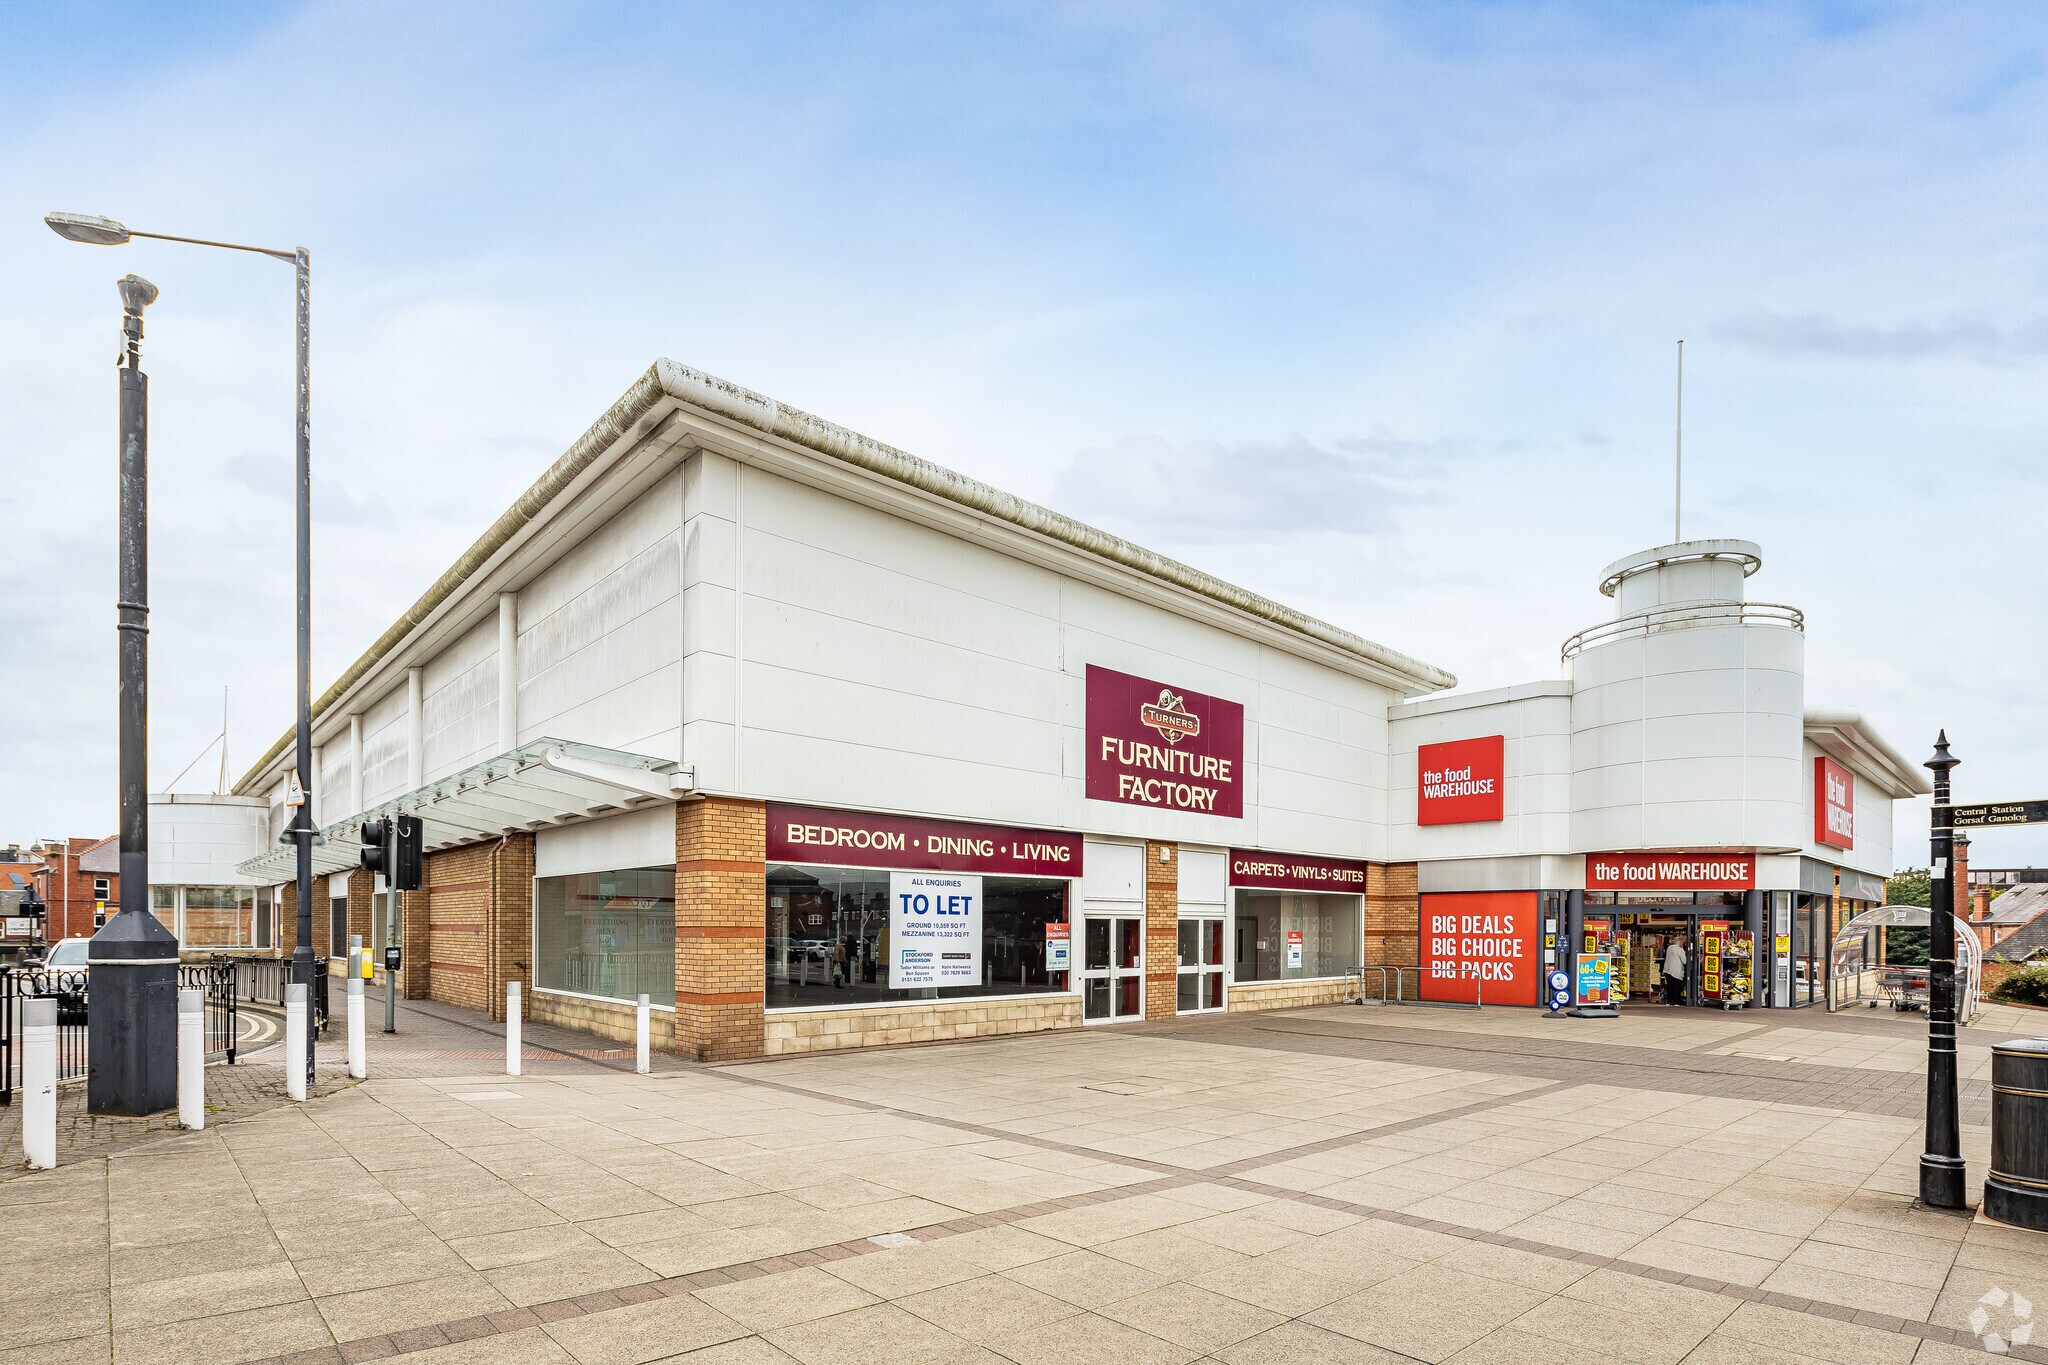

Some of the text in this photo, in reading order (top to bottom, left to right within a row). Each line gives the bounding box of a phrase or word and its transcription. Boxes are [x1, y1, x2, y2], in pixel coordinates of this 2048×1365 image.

[1148, 710, 1194, 730] TURNERS
[1101, 735, 1232, 783] FURNITURE
[1423, 765, 1471, 785] the food
[1118, 774, 1218, 811] FACTORY
[1423, 778, 1495, 799] WAREHOUSE
[1827, 771, 1846, 807] the food
[1954, 805, 2024, 816] Central Station
[1954, 813, 2028, 825] Gorsaf Ganolog
[787, 823, 1070, 862] BEDROOM DINING LIVING
[1234, 861, 1364, 882] CARPETS VINYLS SUITES
[1595, 862, 1749, 881] the food WAREHOUSE
[911, 878, 962, 888] ALL ENQUIRIES
[899, 893, 973, 916] TO LET
[1432, 915, 1514, 935] BIG DEALS
[1432, 937, 1457, 957] BIG
[1461, 937, 1523, 958] CHOICE
[1708, 938, 1717, 948] BIG
[1431, 960, 1514, 981] BIG PACKS
[1707, 957, 1717, 967] BIG
[1707, 976, 1716, 985] BIG
